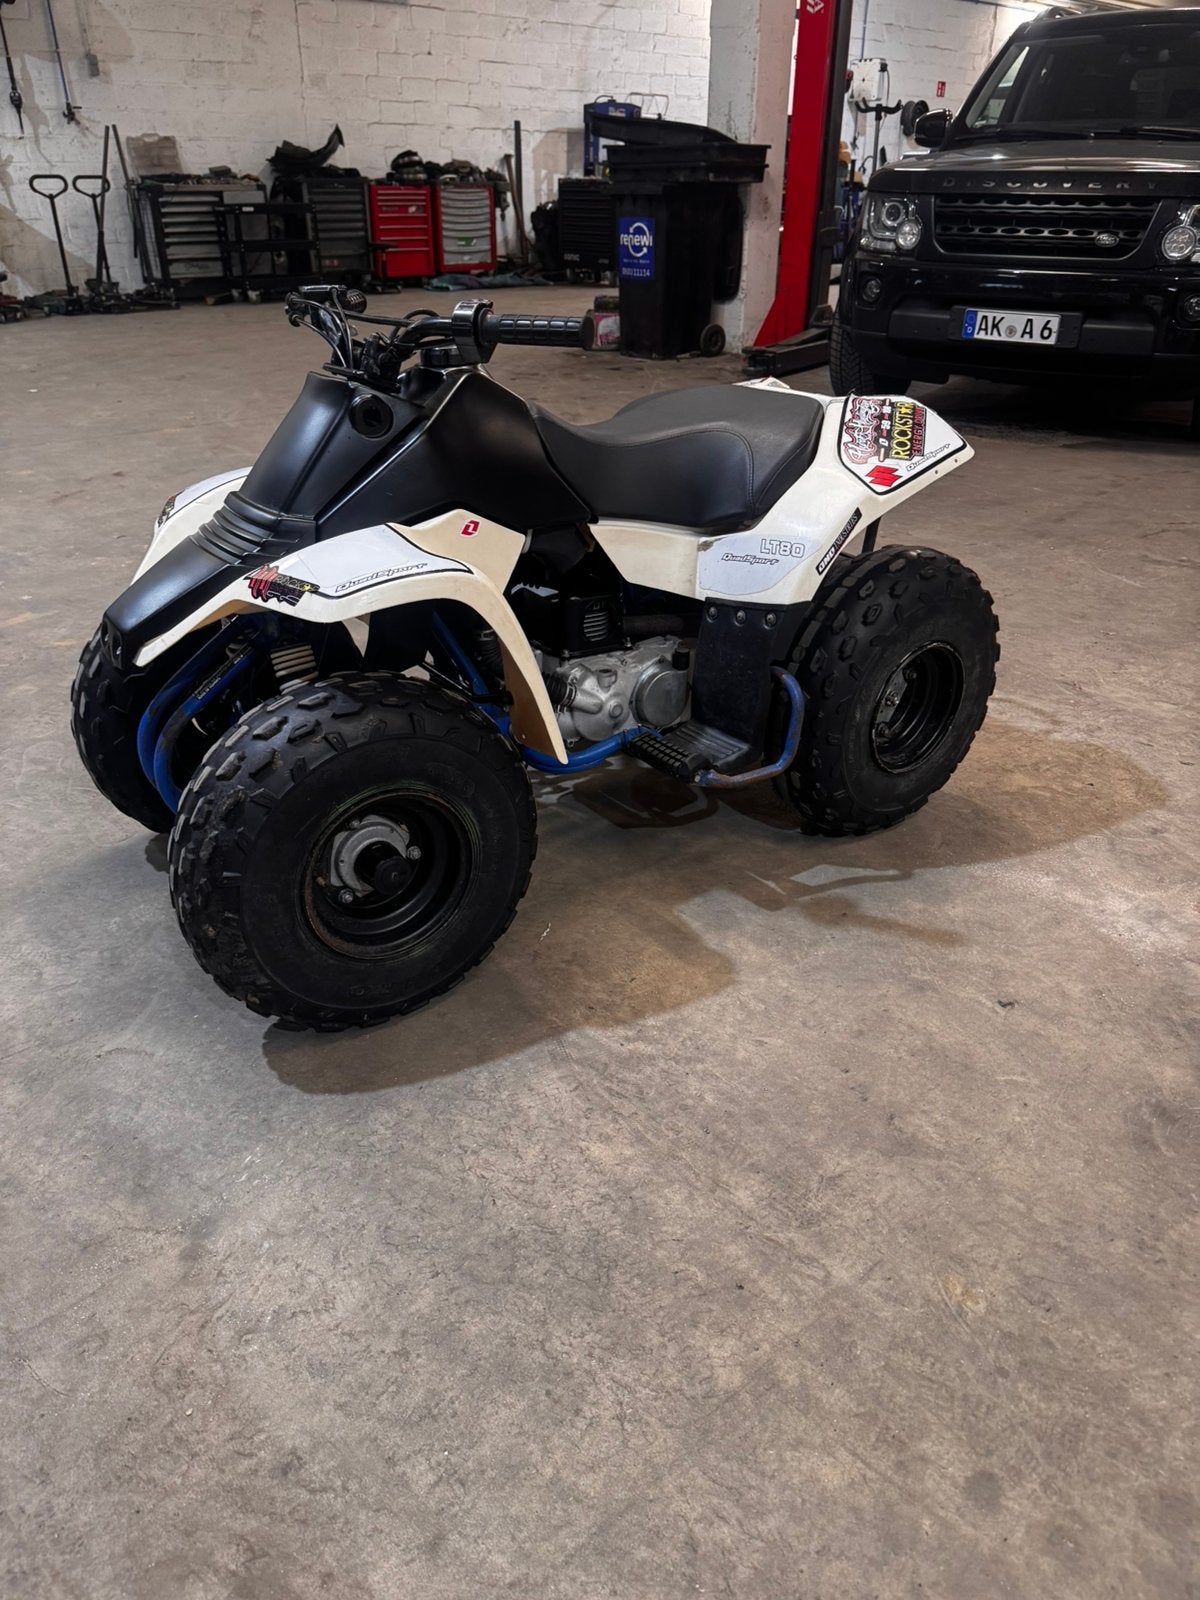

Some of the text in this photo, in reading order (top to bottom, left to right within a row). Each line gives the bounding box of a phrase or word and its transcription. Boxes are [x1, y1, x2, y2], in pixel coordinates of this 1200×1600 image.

[620, 234, 653, 247] renewi
[976, 315, 1005, 337] AK
[912, 425, 923, 456] ENERGY
[759, 538, 806, 558] LT80
[721, 552, 780, 565] QuadSport
